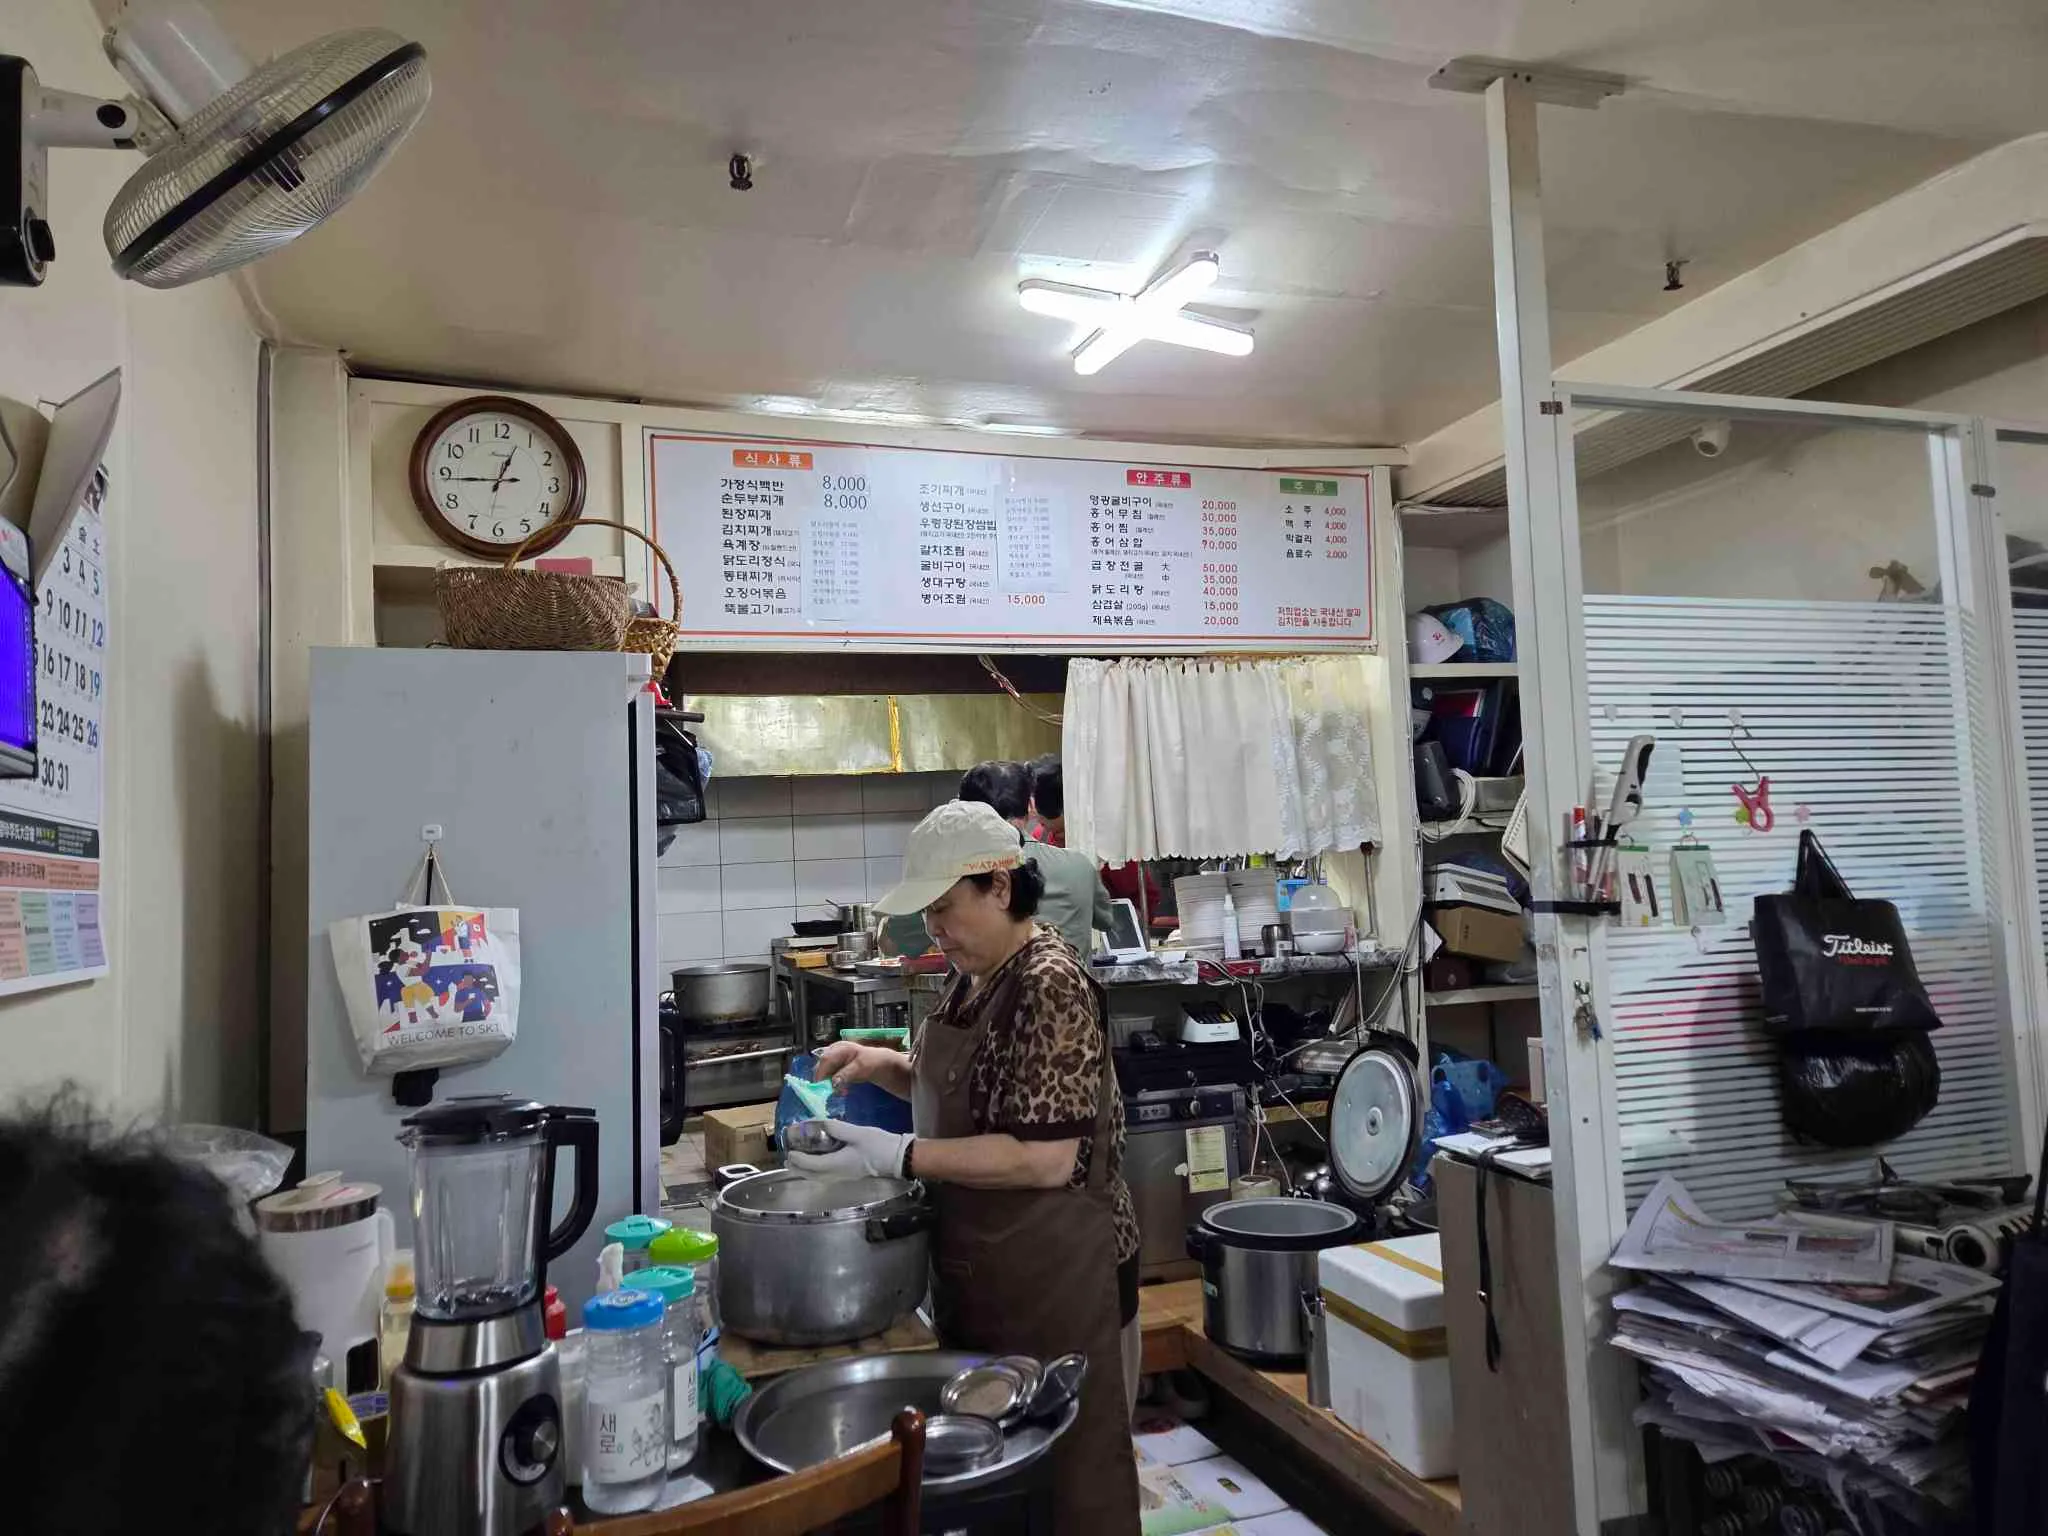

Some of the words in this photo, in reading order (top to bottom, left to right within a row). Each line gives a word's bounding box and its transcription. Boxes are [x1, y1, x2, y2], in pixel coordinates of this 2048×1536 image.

[469, 428, 479, 444] 11
[495, 423, 510, 439] 12
[448, 443, 464, 459] 10
[543, 451, 552, 466] 2
[440, 466, 452, 482] 9
[548, 477, 560, 494] 3
[720, 478, 784, 492] 가정식백반
[446, 493, 458, 509] 8
[721, 493, 784, 506] 순두부찌개
[1202, 500, 1236, 510] 20,000
[539, 502, 550, 517] 4
[920, 501, 965, 513] 생선구이
[722, 508, 771, 521] 된장찌개
[1202, 513, 1237, 523] 30,000
[468, 514, 478, 530] 7
[520, 519, 531, 534] 5
[493, 521, 504, 537] 6
[722, 524, 772, 537] 김치찌개
[1202, 527, 1237, 537] 35,000
[920, 545, 965, 557] 갈치조림
[1202, 540, 1238, 550] 70,000
[723, 555, 785, 567] 닭도리정식
[920, 561, 965, 572] 굴비구이
[63, 546, 70, 574] 3
[79, 559, 85, 584] 4
[94, 570, 100, 595] 5
[1203, 564, 1238, 573] 50,000
[723, 570, 773, 583] 동태찌개
[921, 577, 965, 588] 생대구탕
[1203, 575, 1238, 584] 35,000
[724, 587, 787, 599] 오징어볶음
[1203, 587, 1238, 596] 40,000
[921, 594, 966, 605] 병어조림
[1008, 594, 1045, 606] 15,000
[1205, 601, 1238, 611] 15,000
[47, 589, 53, 616] 9
[59, 598, 70, 629] 10
[76, 609, 86, 638] 11
[92, 618, 103, 647] 12
[1204, 617, 1238, 626] 20,000
[43, 644, 54, 675] 16
[58, 653, 71, 681] 17
[75, 662, 85, 690] 18
[90, 670, 101, 697] 19
[41, 700, 54, 731] 23
[57, 707, 70, 736] 24
[72, 714, 84, 743] 25
[87, 720, 98, 748] 26
[42, 758, 54, 788] 30
[57, 762, 69, 791] 31
[1823, 934, 1893, 957] Titleist
[388, 1027, 456, 1046] WELCOME
[459, 1026, 475, 1037] TO
